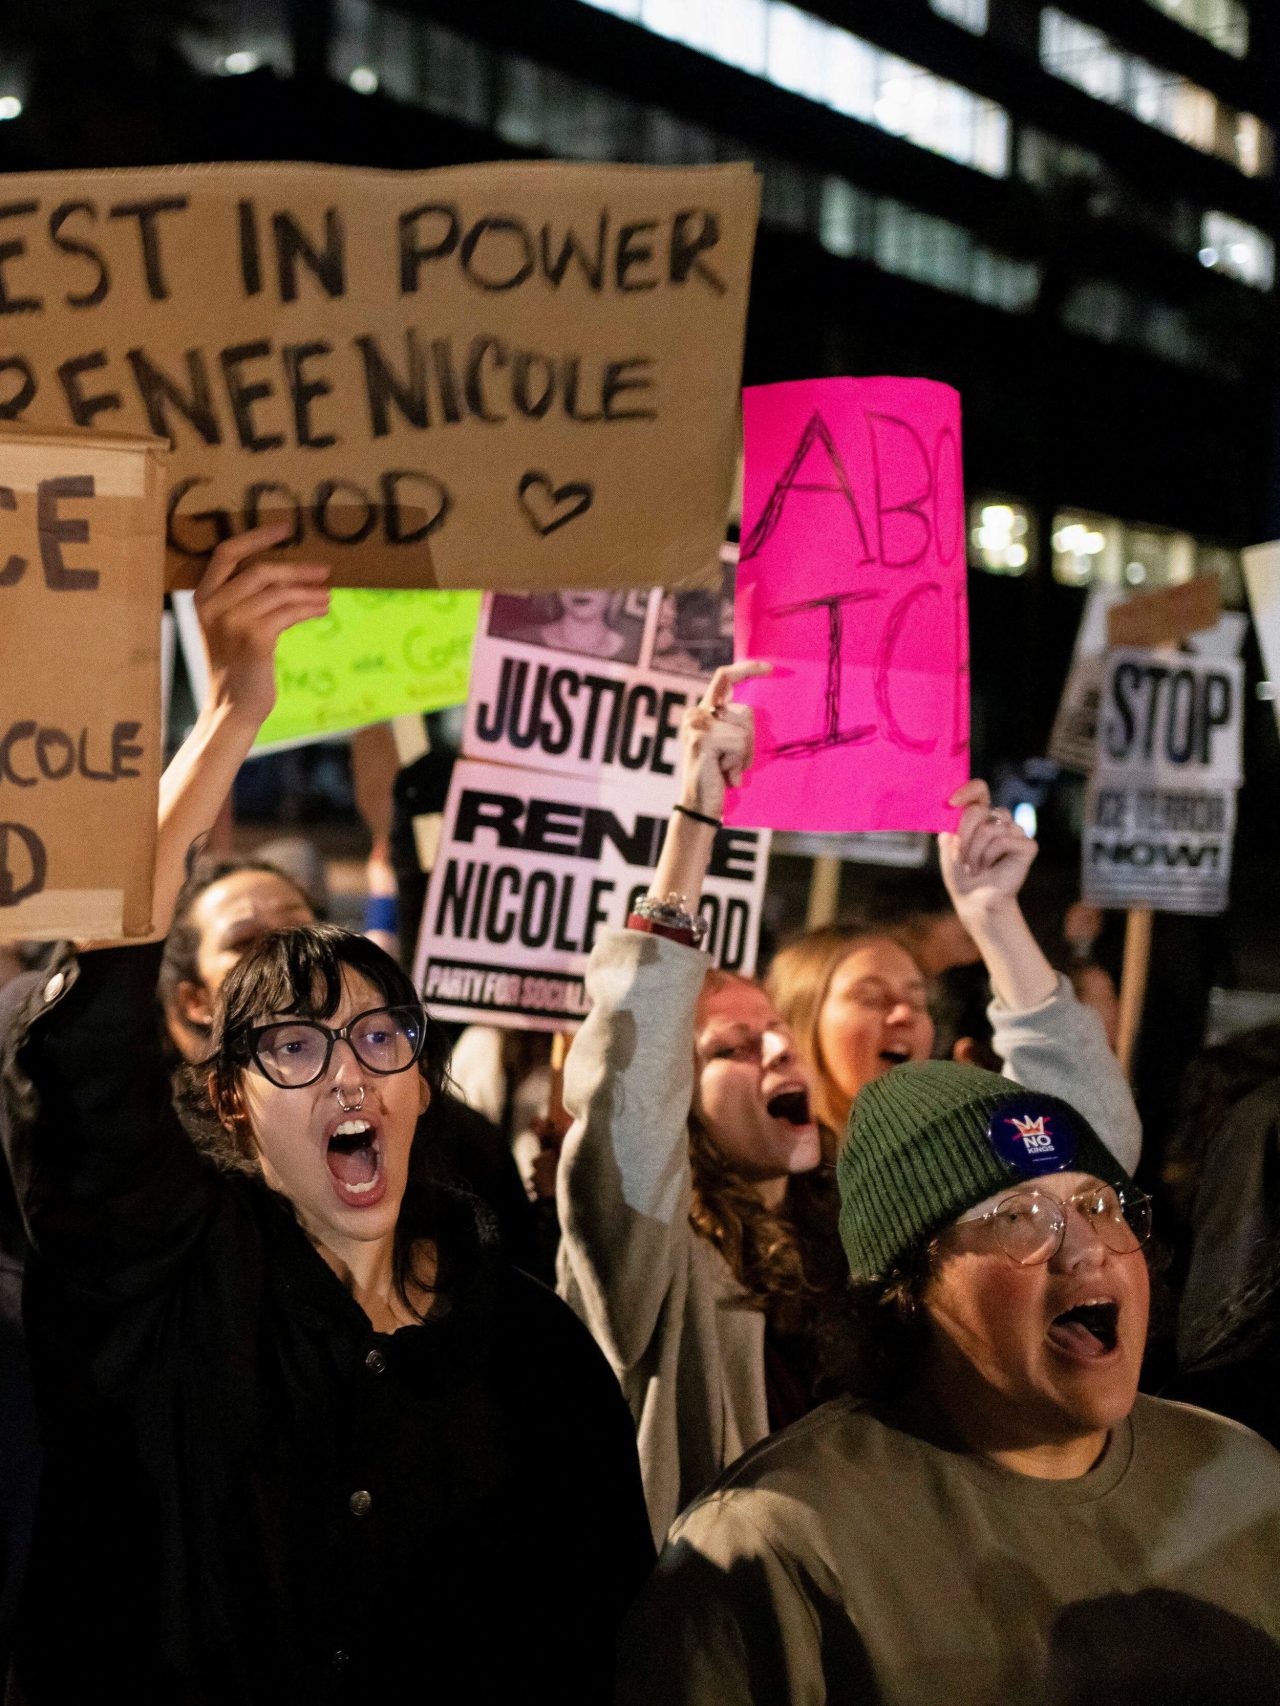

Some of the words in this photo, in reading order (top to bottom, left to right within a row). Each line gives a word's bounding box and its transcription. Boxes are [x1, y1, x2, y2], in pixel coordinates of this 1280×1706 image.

[240, 197, 348, 302] IN
[400, 203, 729, 296] POWER
[355, 327, 660, 439] NICOLE
[169, 468, 456, 553] GOOD
[475, 656, 686, 776] JUSTICE
[1107, 662, 1231, 765] STOP
[1091, 841, 1220, 870] NOW!
[433, 858, 616, 955] NICOLE
[425, 964, 485, 1004] PARTY
[481, 971, 523, 1008] FOR
[1023, 1134, 1051, 1148] NO
[1028, 1145, 1055, 1154] KINGS
